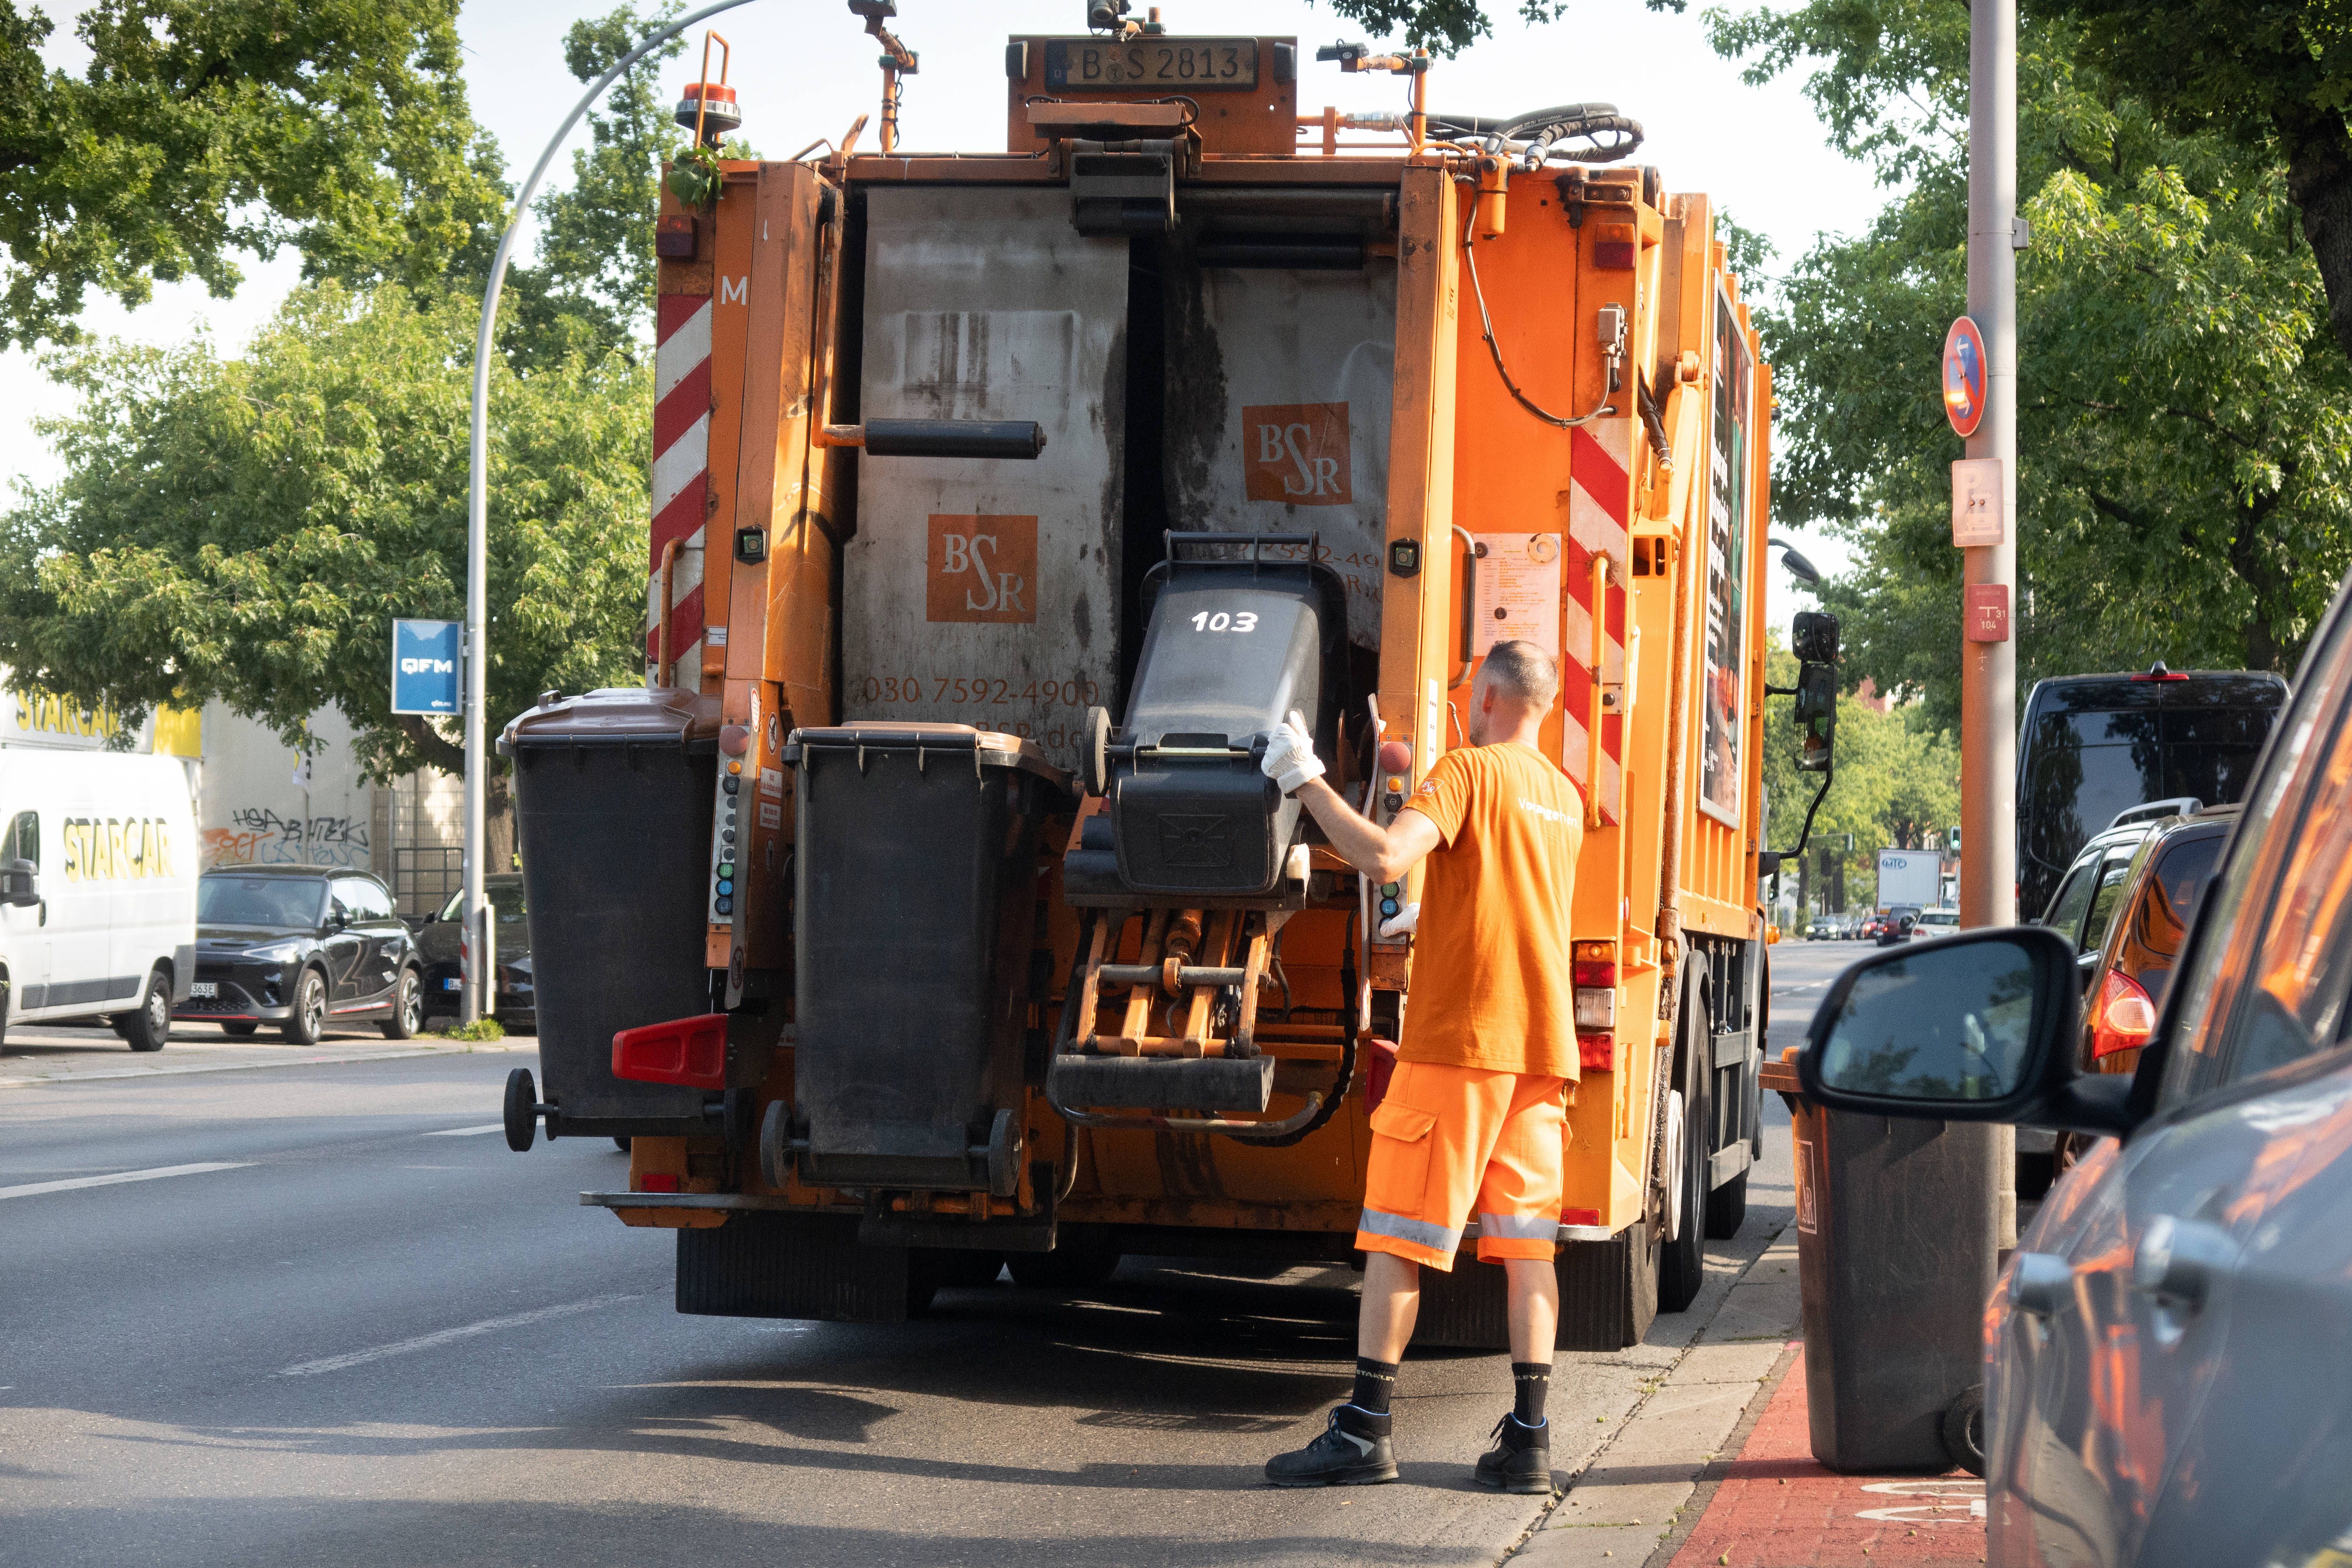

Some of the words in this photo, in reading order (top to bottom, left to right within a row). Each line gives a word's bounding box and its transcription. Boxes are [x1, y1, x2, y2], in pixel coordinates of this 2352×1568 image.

[1082, 49, 1100, 79] B
[1127, 48, 1145, 79] S
[1157, 47, 1238, 79] 2813
[720, 276, 748, 305] M
[1258, 422, 1342, 496] BSR
[942, 534, 1027, 612] BSR
[1191, 611, 1259, 632] 103
[401, 658, 453, 675] QFM
[864, 677, 920, 703] 030
[933, 677, 1100, 707] 7592-4900
[63, 817, 175, 883] STARCAR
